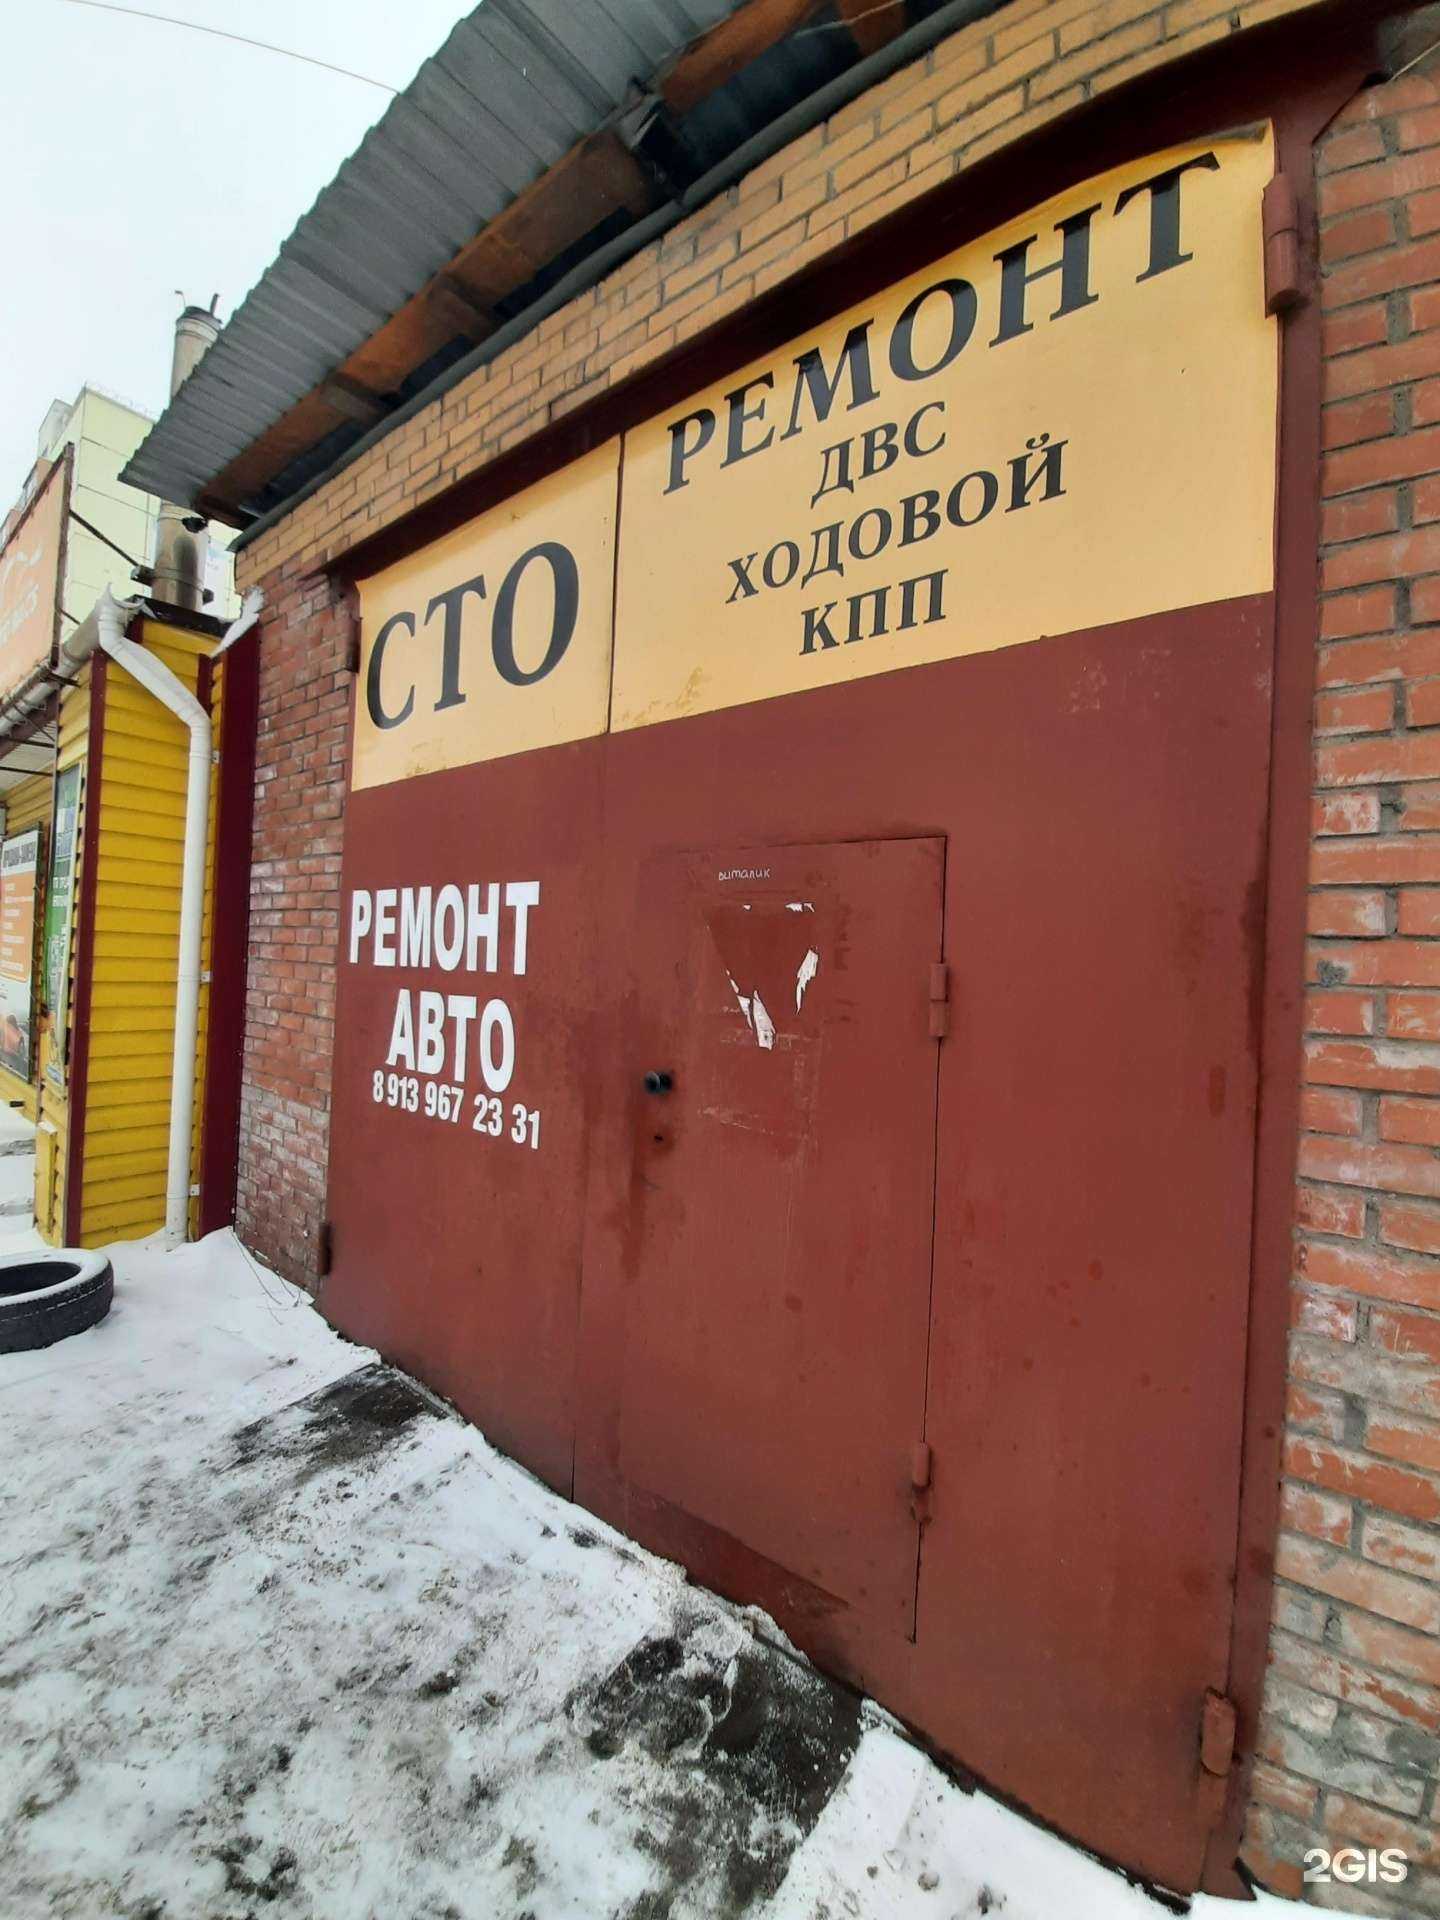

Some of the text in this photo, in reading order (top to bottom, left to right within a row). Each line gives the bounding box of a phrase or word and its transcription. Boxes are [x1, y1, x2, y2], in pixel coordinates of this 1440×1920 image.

[663, 151, 1220, 496] РЕМОНТ
[811, 401, 946, 509] ДВС
[725, 432, 1069, 604] ХОДОВОЙ
[366, 541, 580, 730] СТО
[799, 569, 949, 656] КПП
[349, 881, 540, 975] РЕМОНТ
[385, 988, 515, 1093] АВТО
[372, 1069, 540, 1150] 8 913 967 23 31
